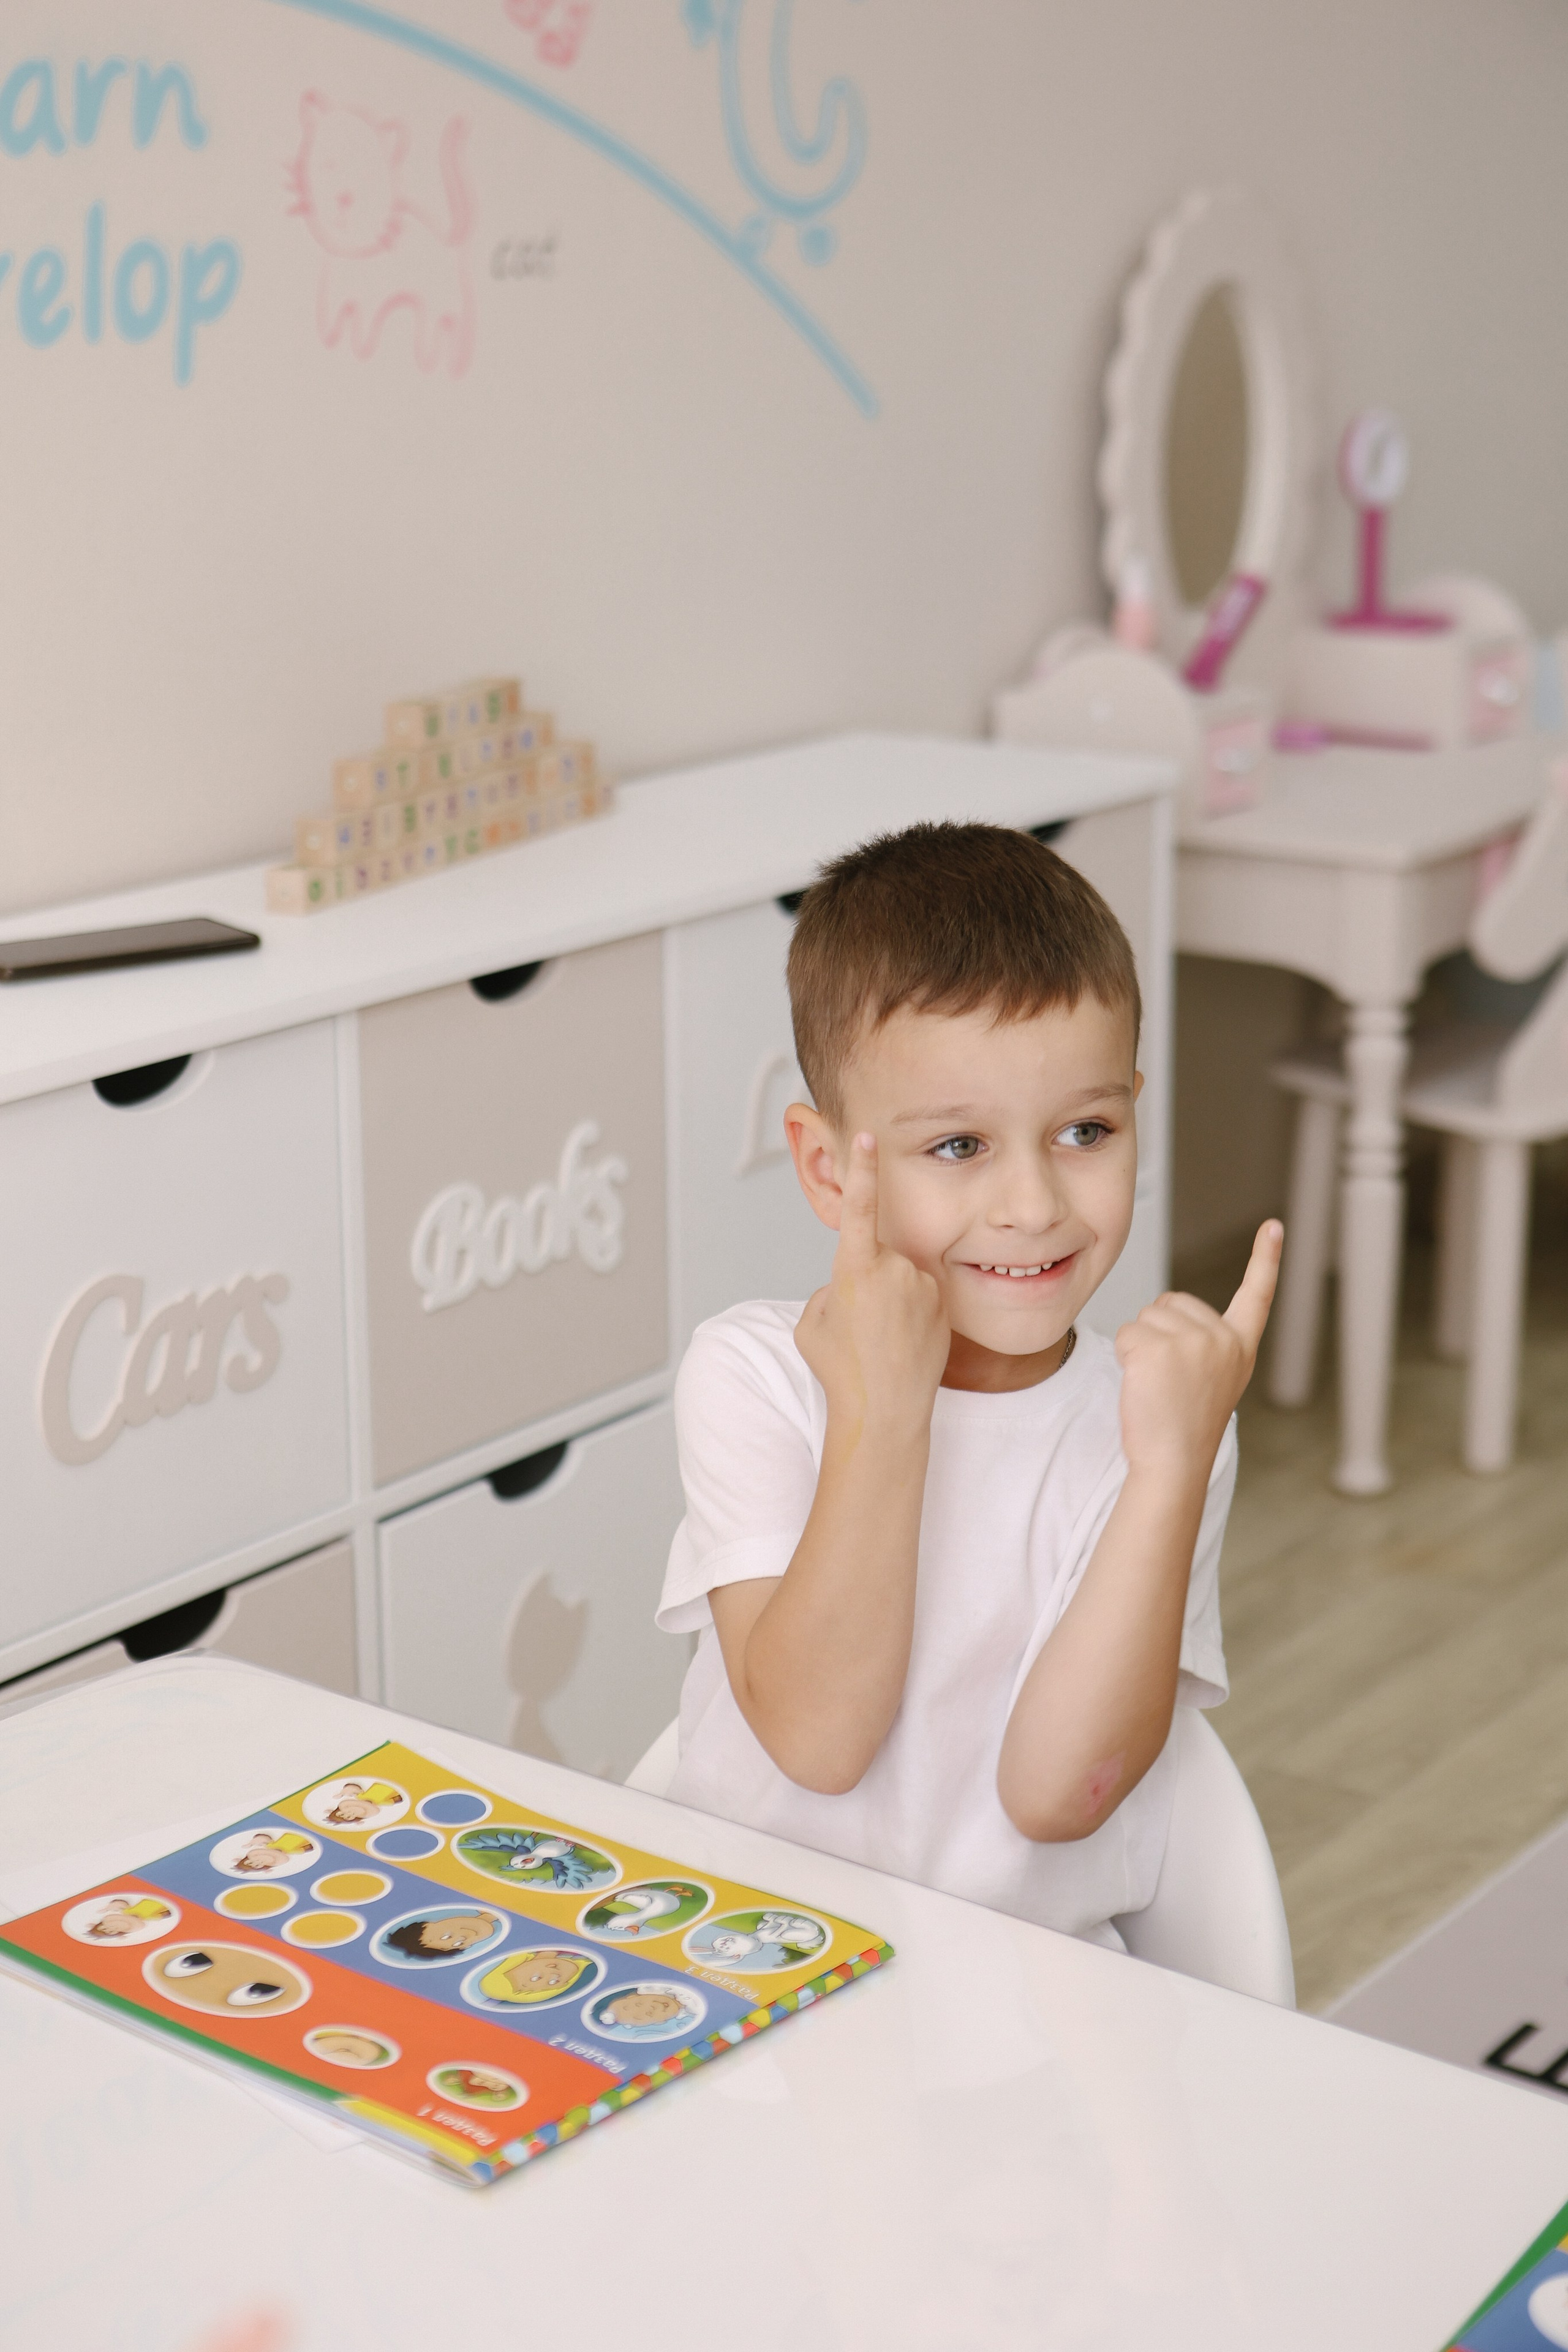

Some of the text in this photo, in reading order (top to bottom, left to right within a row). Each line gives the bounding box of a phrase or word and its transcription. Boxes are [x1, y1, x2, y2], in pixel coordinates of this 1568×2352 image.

[410, 1118, 630, 1313] Books
[38, 1269, 291, 1466] Cars
[684, 1966, 760, 2000] Раздел 3
[548, 2035, 627, 2075] Раздел 2
